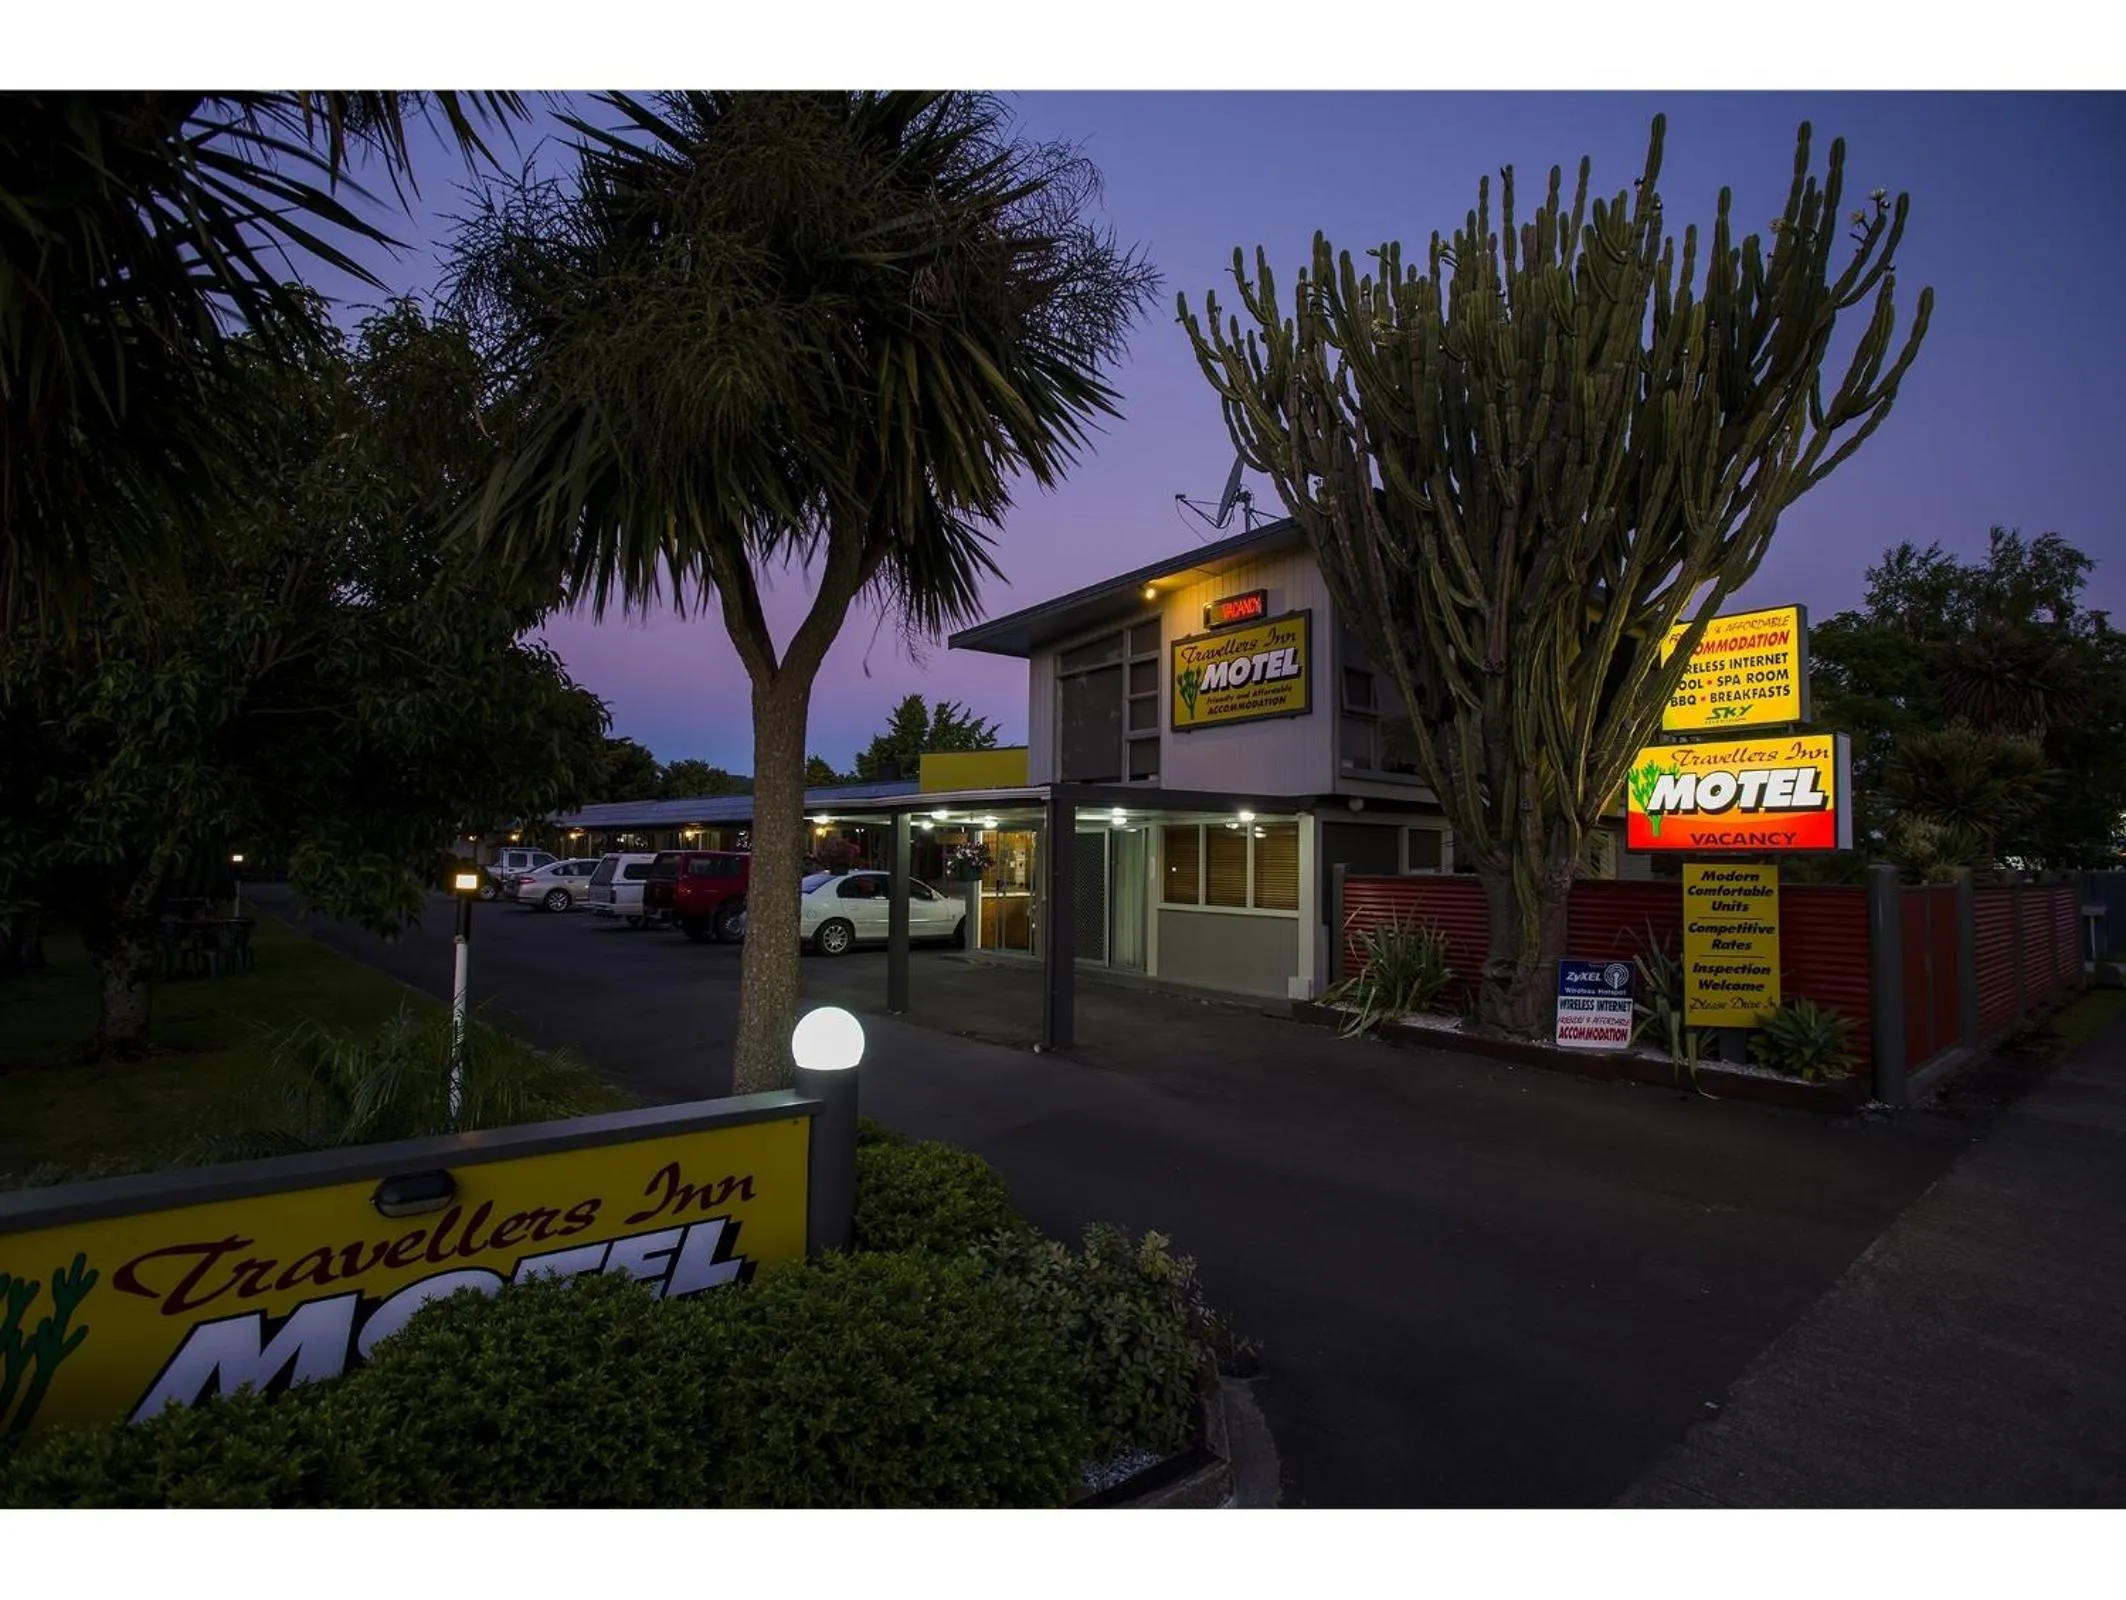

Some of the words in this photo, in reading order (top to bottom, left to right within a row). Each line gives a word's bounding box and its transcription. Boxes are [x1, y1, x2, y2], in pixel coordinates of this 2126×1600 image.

[1693, 630, 1790, 656] OMMODATION
[1687, 659, 1725, 674] RELESS
[1729, 652, 1788, 669] INTERNET
[1200, 647, 1299, 694] MOTEL
[1680, 678, 1704, 691] OOL
[1717, 676, 1740, 686] SPA
[1746, 668, 1789, 684] ROOM
[1671, 695, 1696, 707] BBQ
[1710, 684, 1790, 703] BREAKFASTS
[1208, 696, 1286, 715] ACCOMMODATION
[1671, 747, 1778, 767] Travellers
[1784, 741, 1829, 761] Inn
[1647, 767, 1829, 815] MOTEL
[1690, 832, 1797, 845] VACANCY
[1701, 870, 1759, 881] Modern
[1687, 885, 1774, 897] Comfortable
[1711, 901, 1750, 912] Units
[1688, 922, 1775, 936] Competitive
[1711, 939, 1752, 950] Rates
[1692, 962, 1771, 976] Inspection
[1566, 971, 1603, 982] ZyXEL
[1699, 979, 1765, 992] Welcome
[1560, 999, 1595, 1011] WIRELESS
[1597, 1000, 1632, 1012] INTERNET
[1559, 1026, 1628, 1041] ACCOMMODATION
[112, 1198, 602, 1316] Travellers
[624, 1161, 756, 1225] Inn
